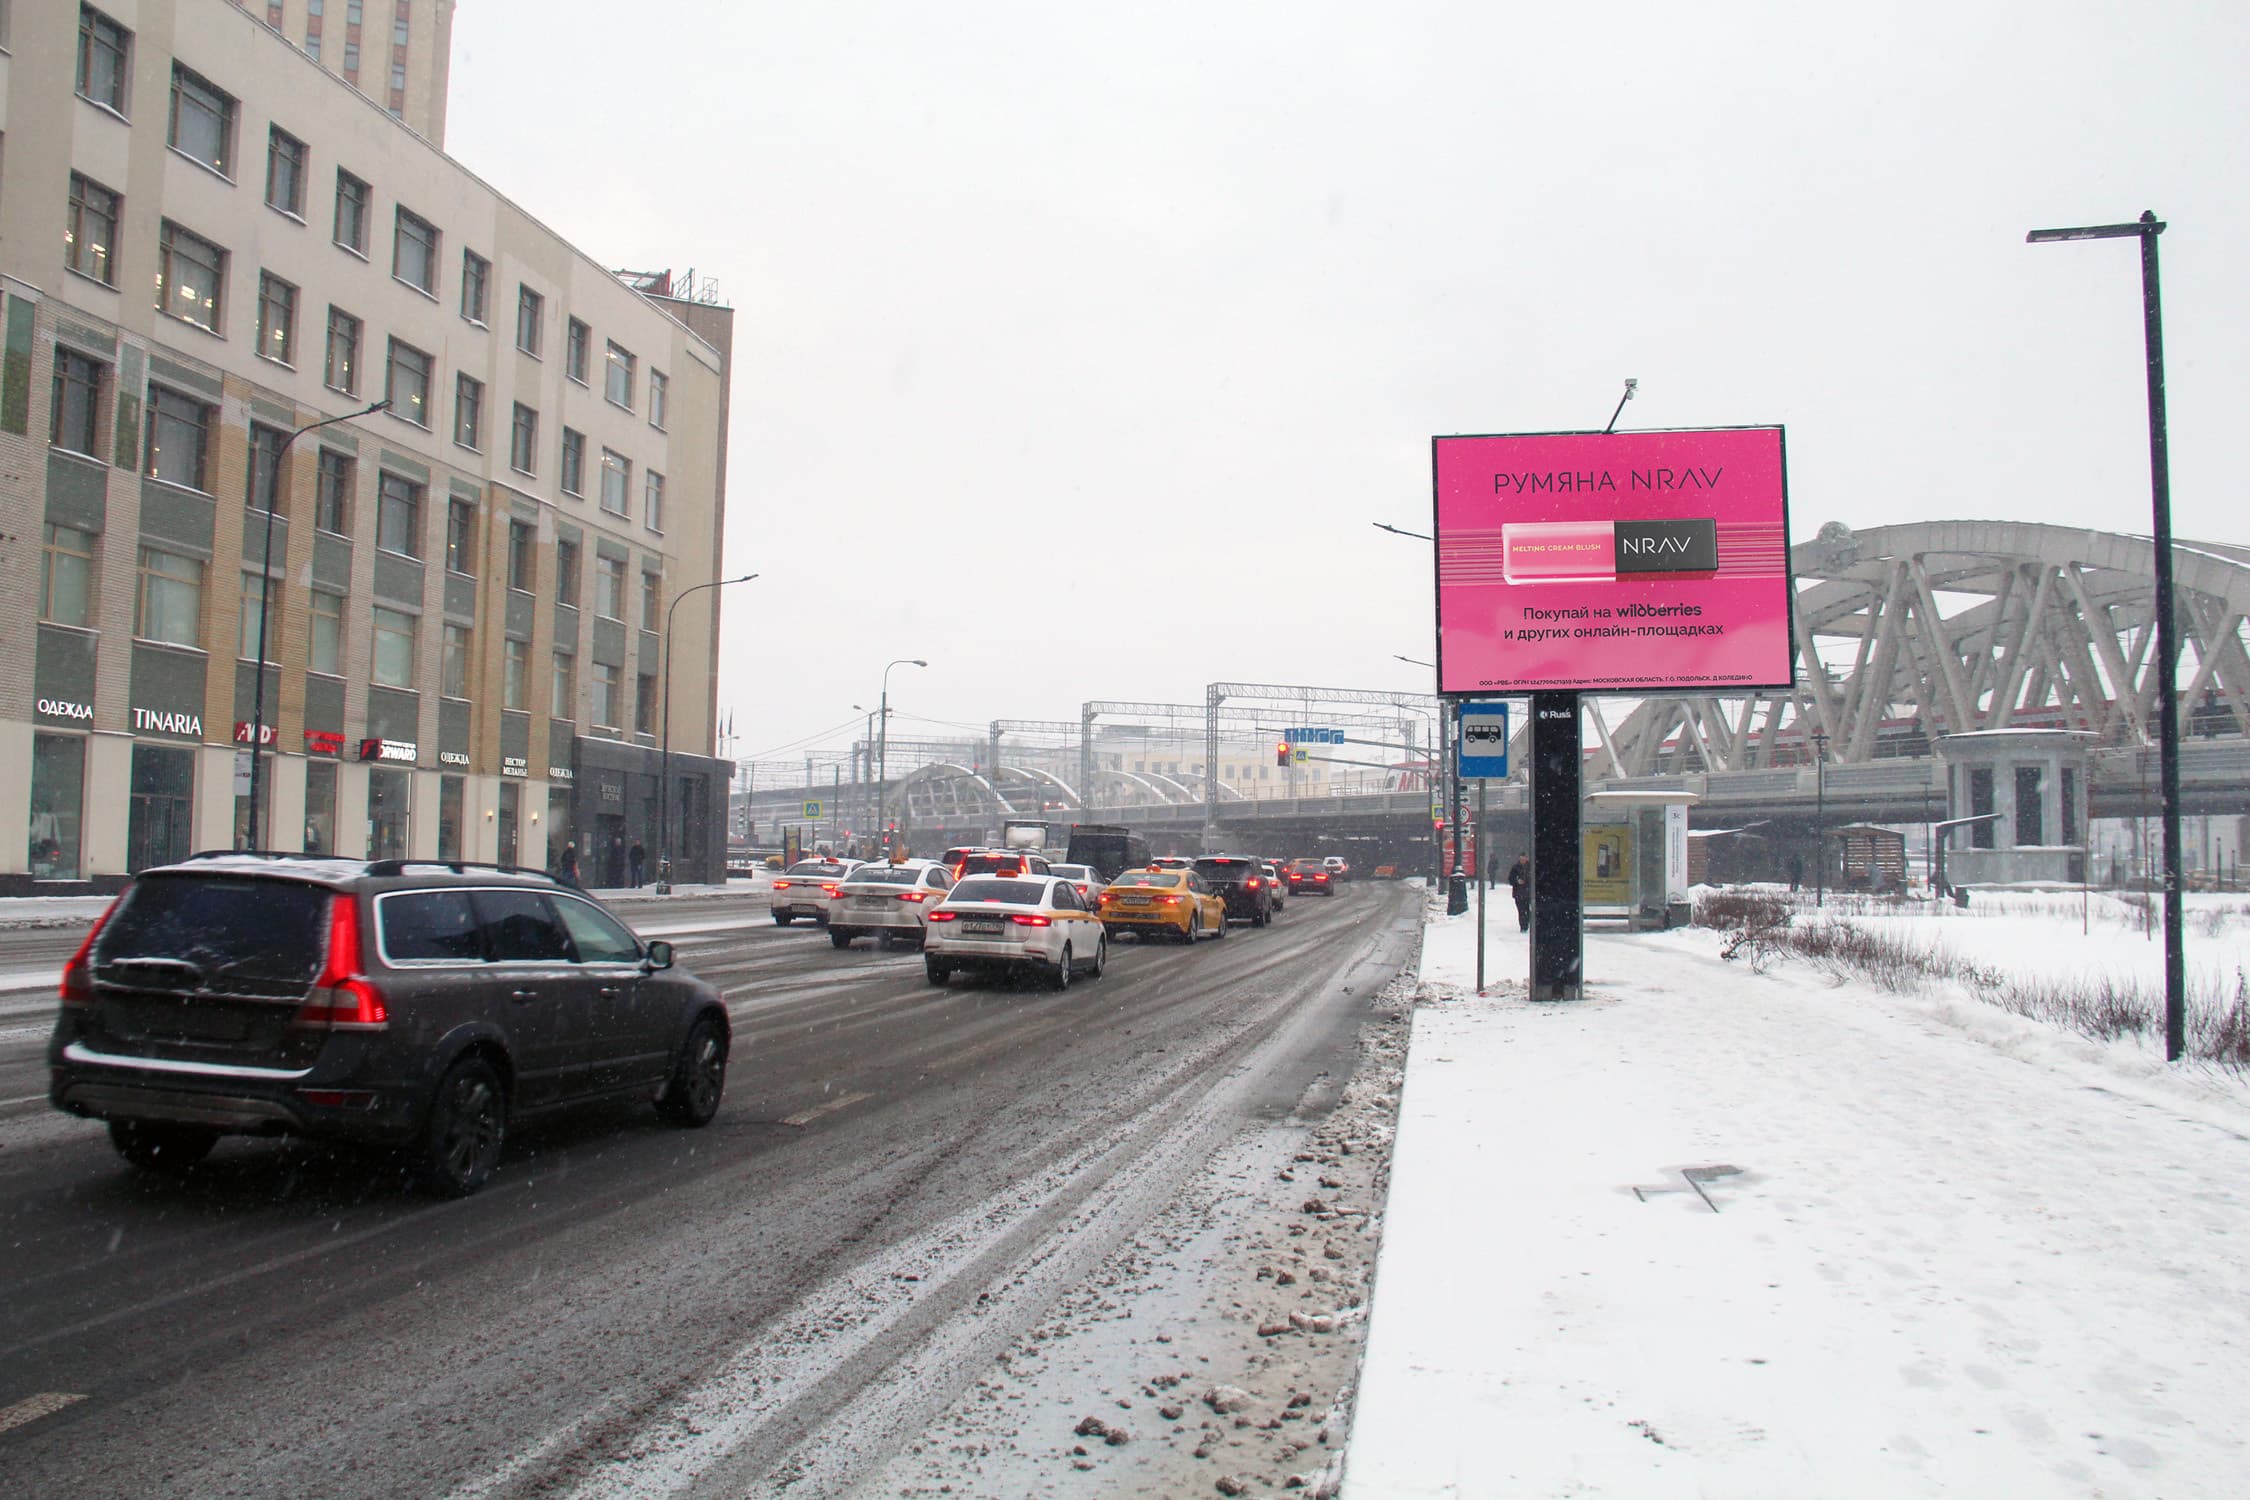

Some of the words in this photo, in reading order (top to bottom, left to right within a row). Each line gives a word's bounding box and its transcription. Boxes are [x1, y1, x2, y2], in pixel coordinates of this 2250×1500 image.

[1494, 470, 1616, 494] РУМЯНА
[1631, 467, 1723, 490] NRAV
[1512, 544, 1546, 553] MELTING
[1547, 544, 1574, 552] CREAM
[1575, 543, 1601, 551] BLUSH
[1623, 536, 1691, 555] NRAV
[1523, 604, 1589, 623] Покупай
[1592, 608, 1612, 618] на
[1616, 603, 1702, 618] wildberries
[1503, 630, 1513, 639] и
[1517, 627, 1570, 642] других
[1574, 624, 1724, 642] онлайн-площадках
[38, 699, 93, 720] ОДЕЖДА
[1549, 709, 1572, 719] Russ
[133, 708, 202, 736] TINARIA
[440, 752, 470, 765] ОДЕЖДА
[549, 767, 573, 779] ОДЕЖДА
